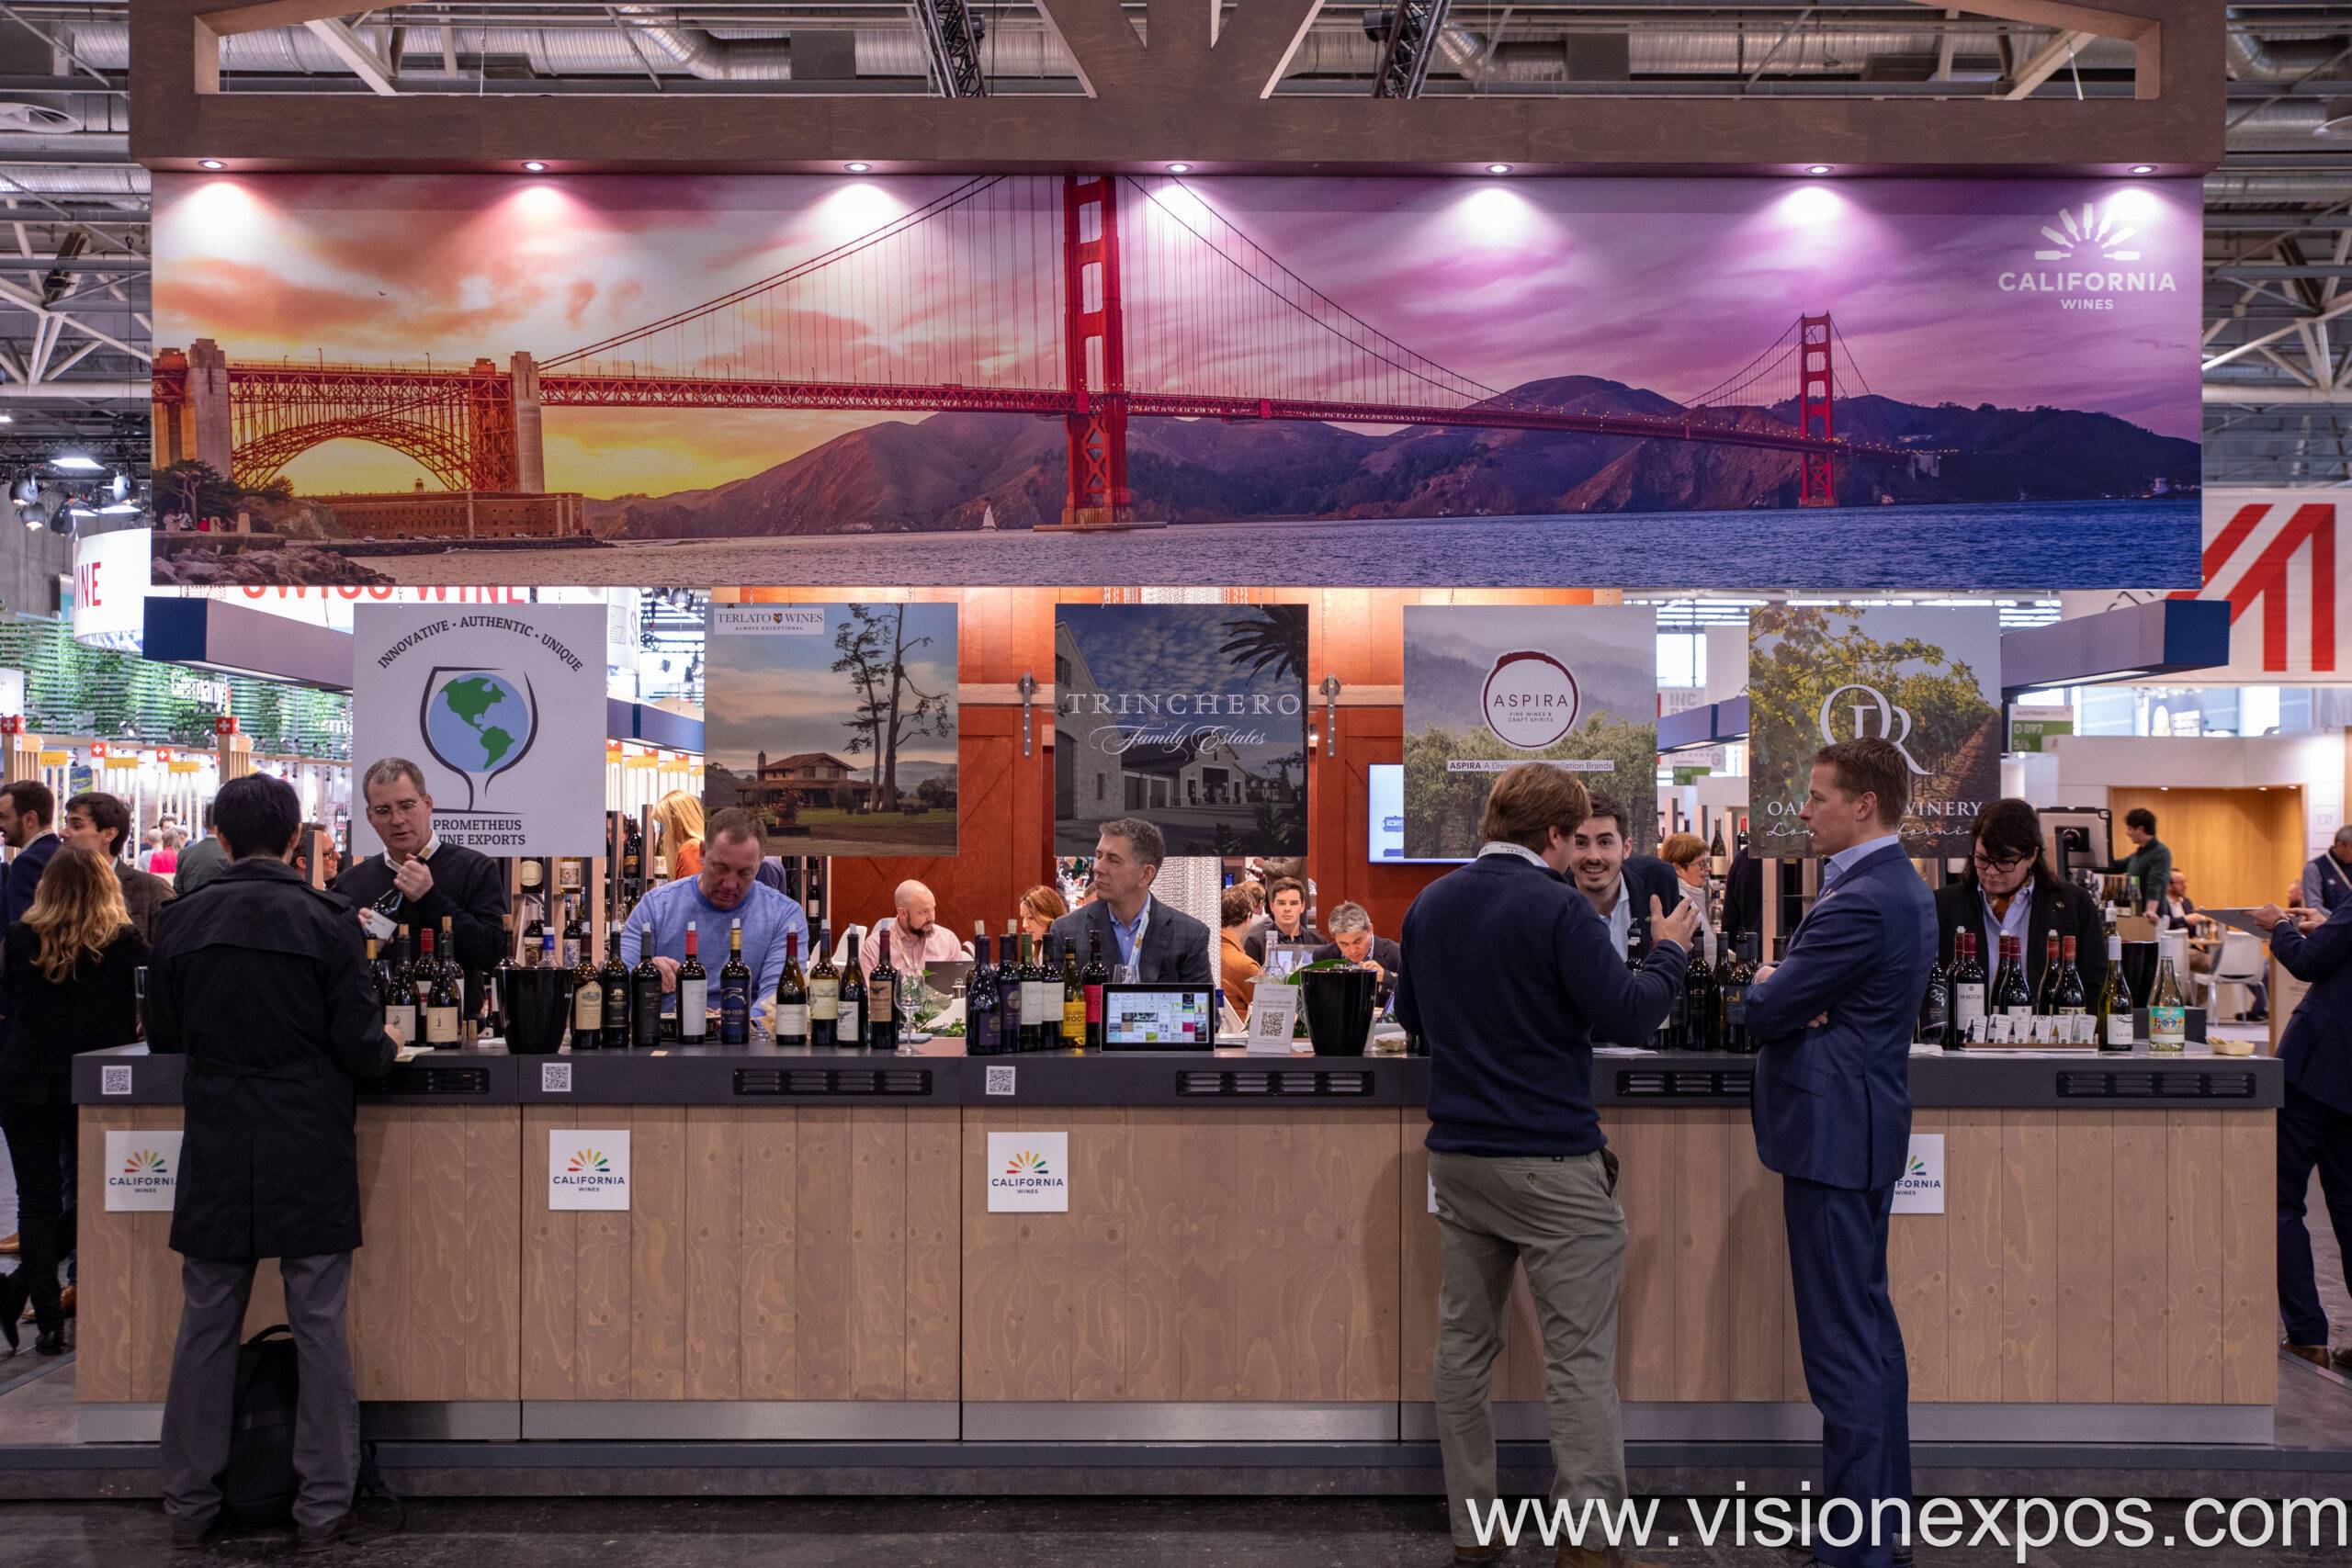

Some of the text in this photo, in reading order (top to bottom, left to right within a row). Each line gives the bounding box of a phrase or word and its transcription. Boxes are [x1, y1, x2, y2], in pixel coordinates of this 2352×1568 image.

[1997, 272, 2177, 292] CALIFORNIA
[2061, 299, 2114, 310] WINES
[718, 613, 823, 624] TERLATO WINES
[378, 615, 584, 672] INNOVATIVE AUTHENTIC UNIQUE
[1066, 694, 1302, 715] TRINCHERO
[1493, 694, 1568, 707] ASPIRA
[1089, 721, 1267, 761] Family Estates
[1449, 761, 1613, 771] ASPIRA A Divisi tellation Brands
[1767, 800, 1806, 817] OA
[433, 818, 523, 831] PROMETHEUS
[467, 834, 526, 846] EXPORTS
[108, 1177, 177, 1186] CALIFORNI
[552, 1176, 626, 1185] CALIFORNIA
[991, 1178, 1064, 1187] CALIFORNIA
[1896, 1179, 1941, 1189] FORNIA
